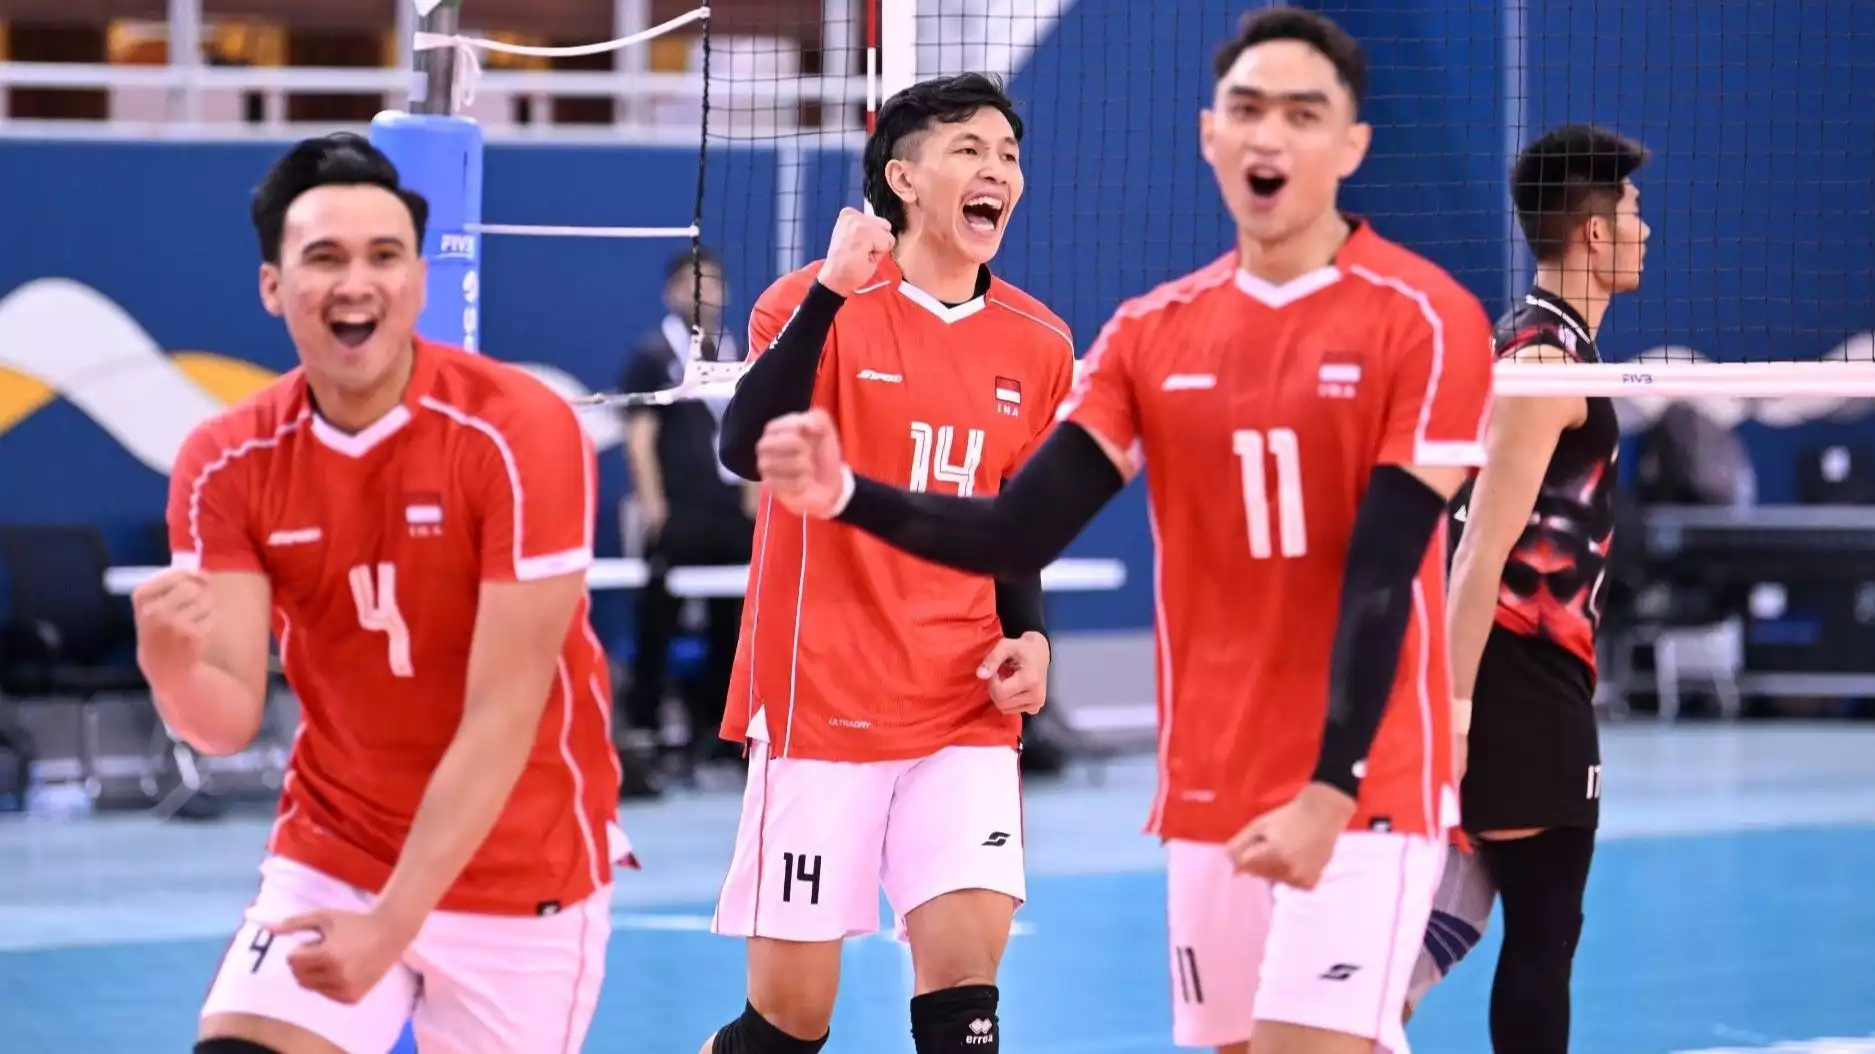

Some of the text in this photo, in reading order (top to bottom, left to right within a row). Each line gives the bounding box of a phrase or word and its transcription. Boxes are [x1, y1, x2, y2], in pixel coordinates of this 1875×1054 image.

[997, 403, 1019, 417] INA
[909, 421, 985, 498] 14
[1232, 428, 1307, 559] 11
[349, 561, 414, 677] 4
[828, 716, 872, 730] ULTRADRY
[783, 851, 821, 905] 14
[250, 926, 275, 975] 4
[1176, 946, 1205, 1004] 11
